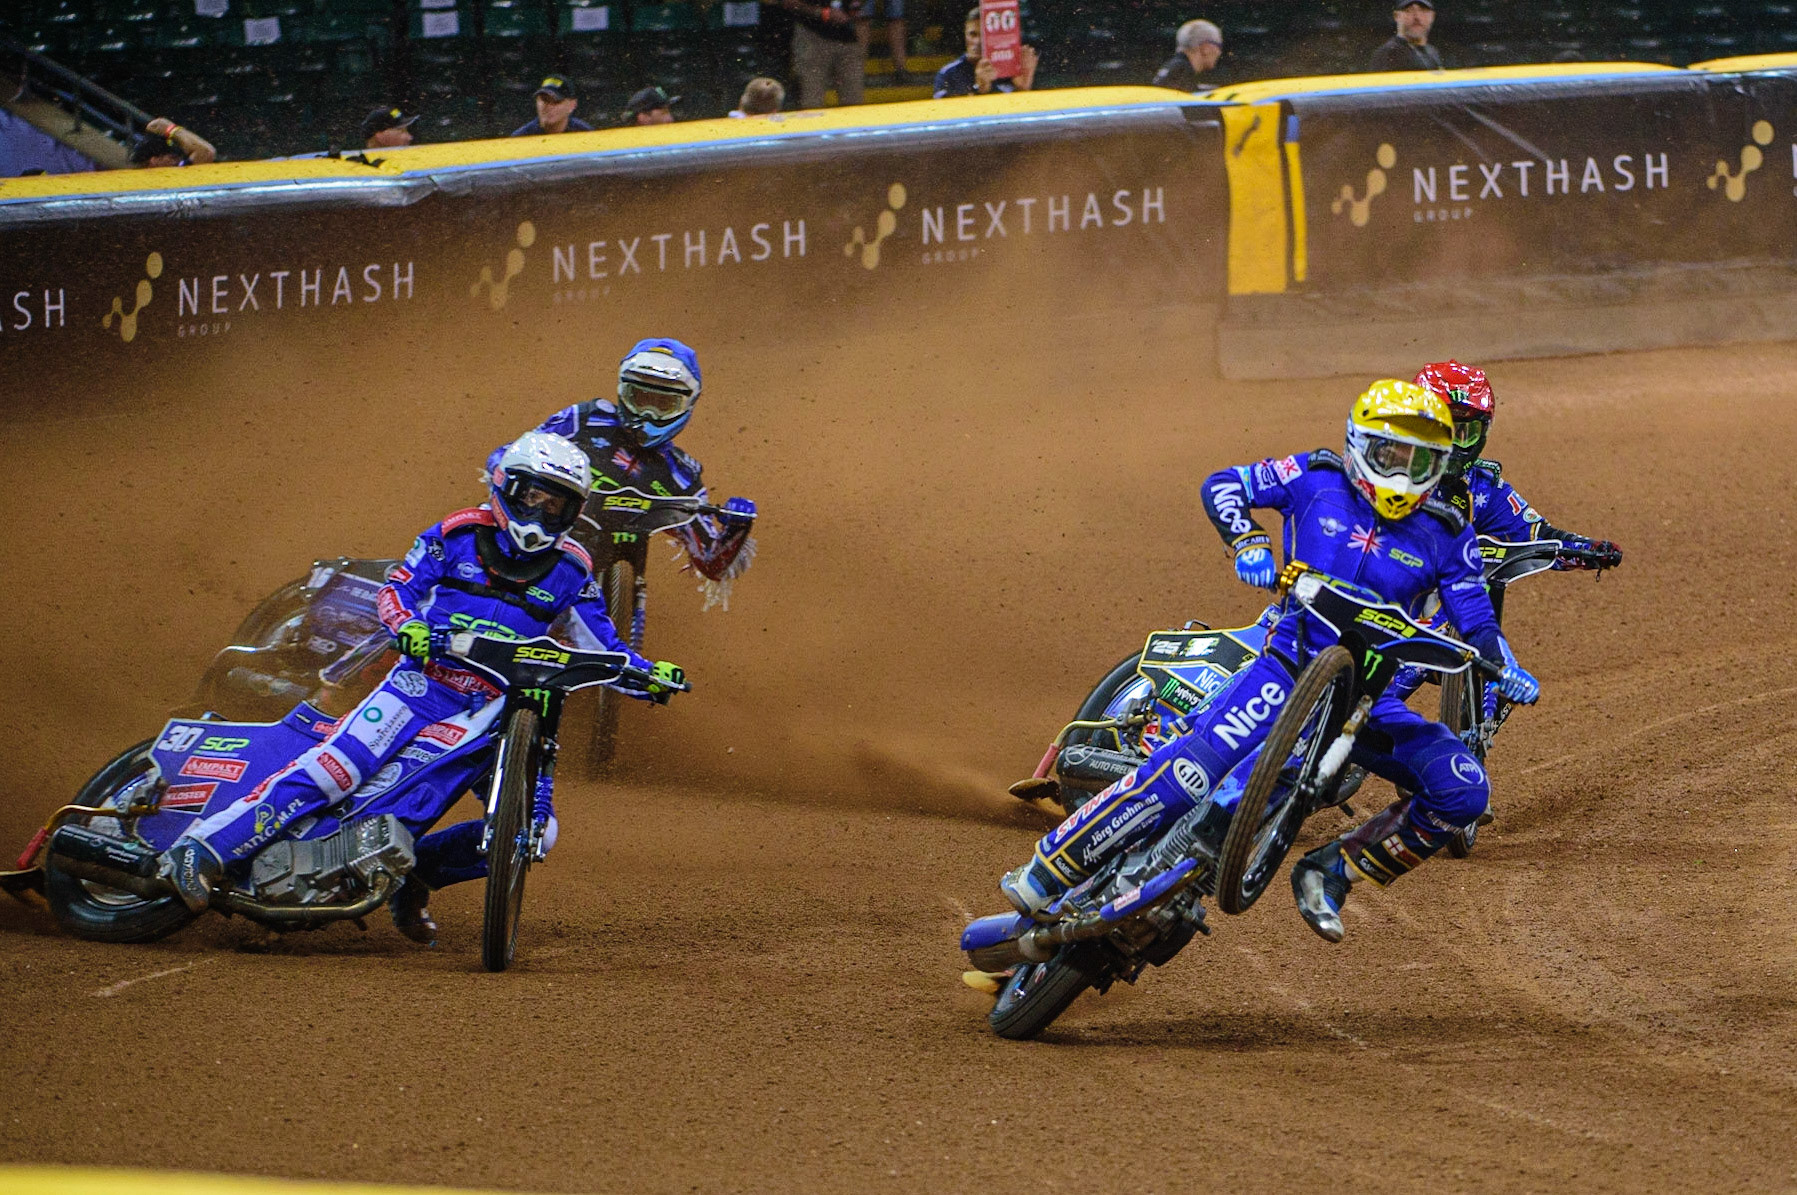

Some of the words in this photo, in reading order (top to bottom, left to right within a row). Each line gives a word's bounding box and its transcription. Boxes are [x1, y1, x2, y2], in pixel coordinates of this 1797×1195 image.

[1413, 152, 1670, 204] NEXTHASH
[922, 187, 1166, 244] NEXTHASH
[552, 219, 806, 283] NEXTHASH
[178, 261, 415, 316] NEXTHASH
[1210, 482, 1252, 533] Nice
[1388, 547, 1424, 568] SGP
[526, 585, 555, 602] SGP
[1358, 608, 1407, 631] SGP
[514, 646, 562, 662] SGP
[1194, 668, 1221, 694] Nic
[1213, 682, 1286, 751] Nice
[157, 725, 206, 753] 30
[199, 736, 250, 752] SGP
[1088, 759, 1109, 772] AUTO
[1091, 826, 1114, 847] Jörg
